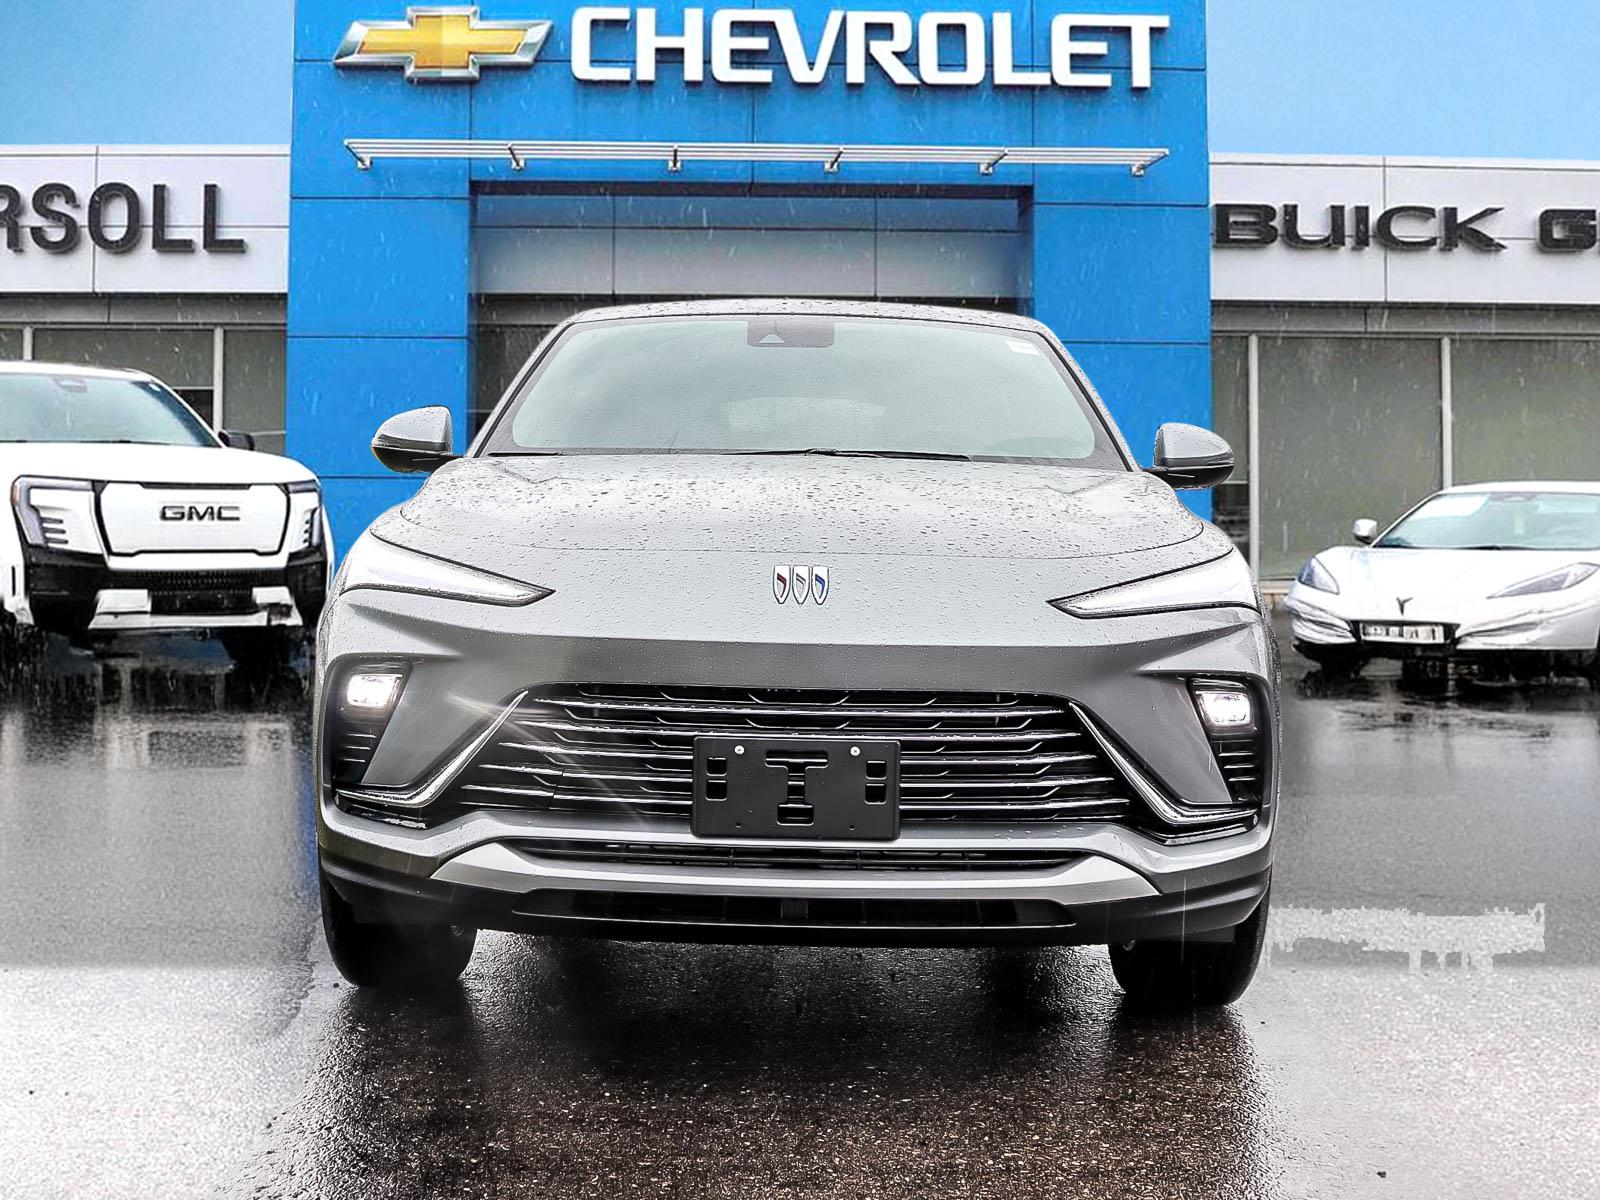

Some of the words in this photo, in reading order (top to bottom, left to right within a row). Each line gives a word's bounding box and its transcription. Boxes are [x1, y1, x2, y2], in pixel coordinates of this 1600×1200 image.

[570, 7, 1170, 89] CHEVROLET
[1212, 202, 1508, 254] BUICK
[159, 505, 241, 522] GMC
